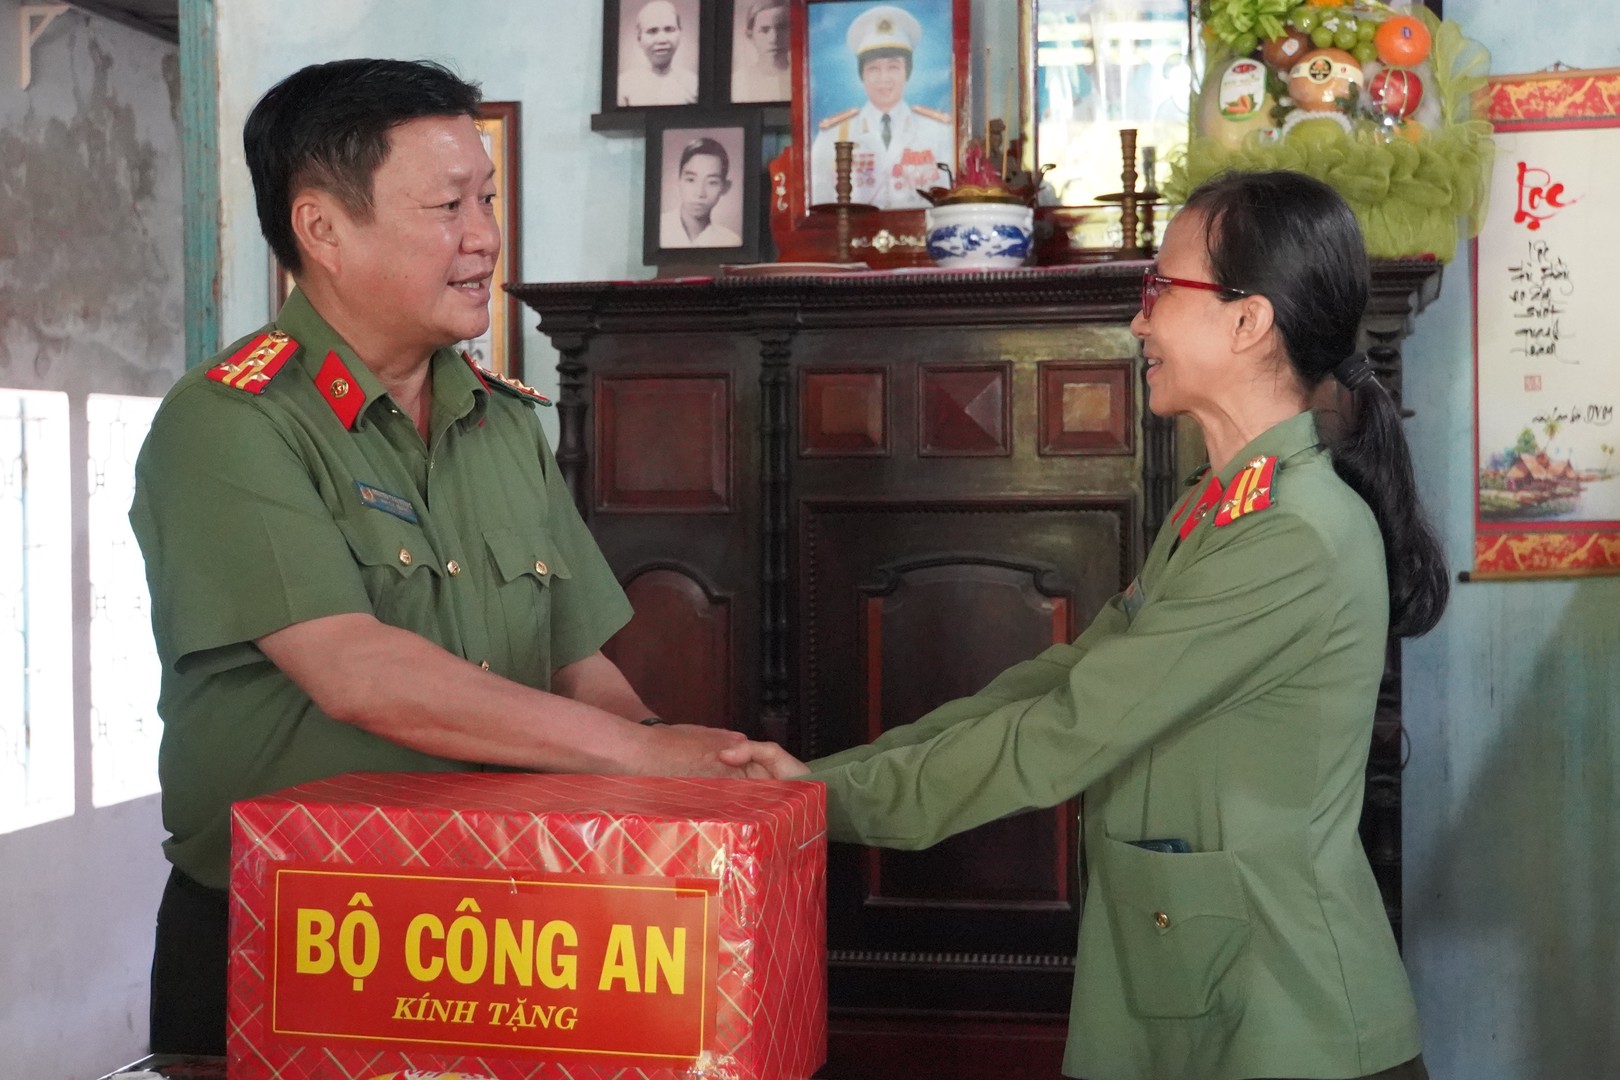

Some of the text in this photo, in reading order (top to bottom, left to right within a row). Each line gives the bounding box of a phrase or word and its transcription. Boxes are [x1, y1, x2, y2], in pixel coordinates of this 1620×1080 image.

[296, 891, 687, 996] BỘ CÔNG AN
[392, 992, 579, 1032] KÍNH TẶNG
